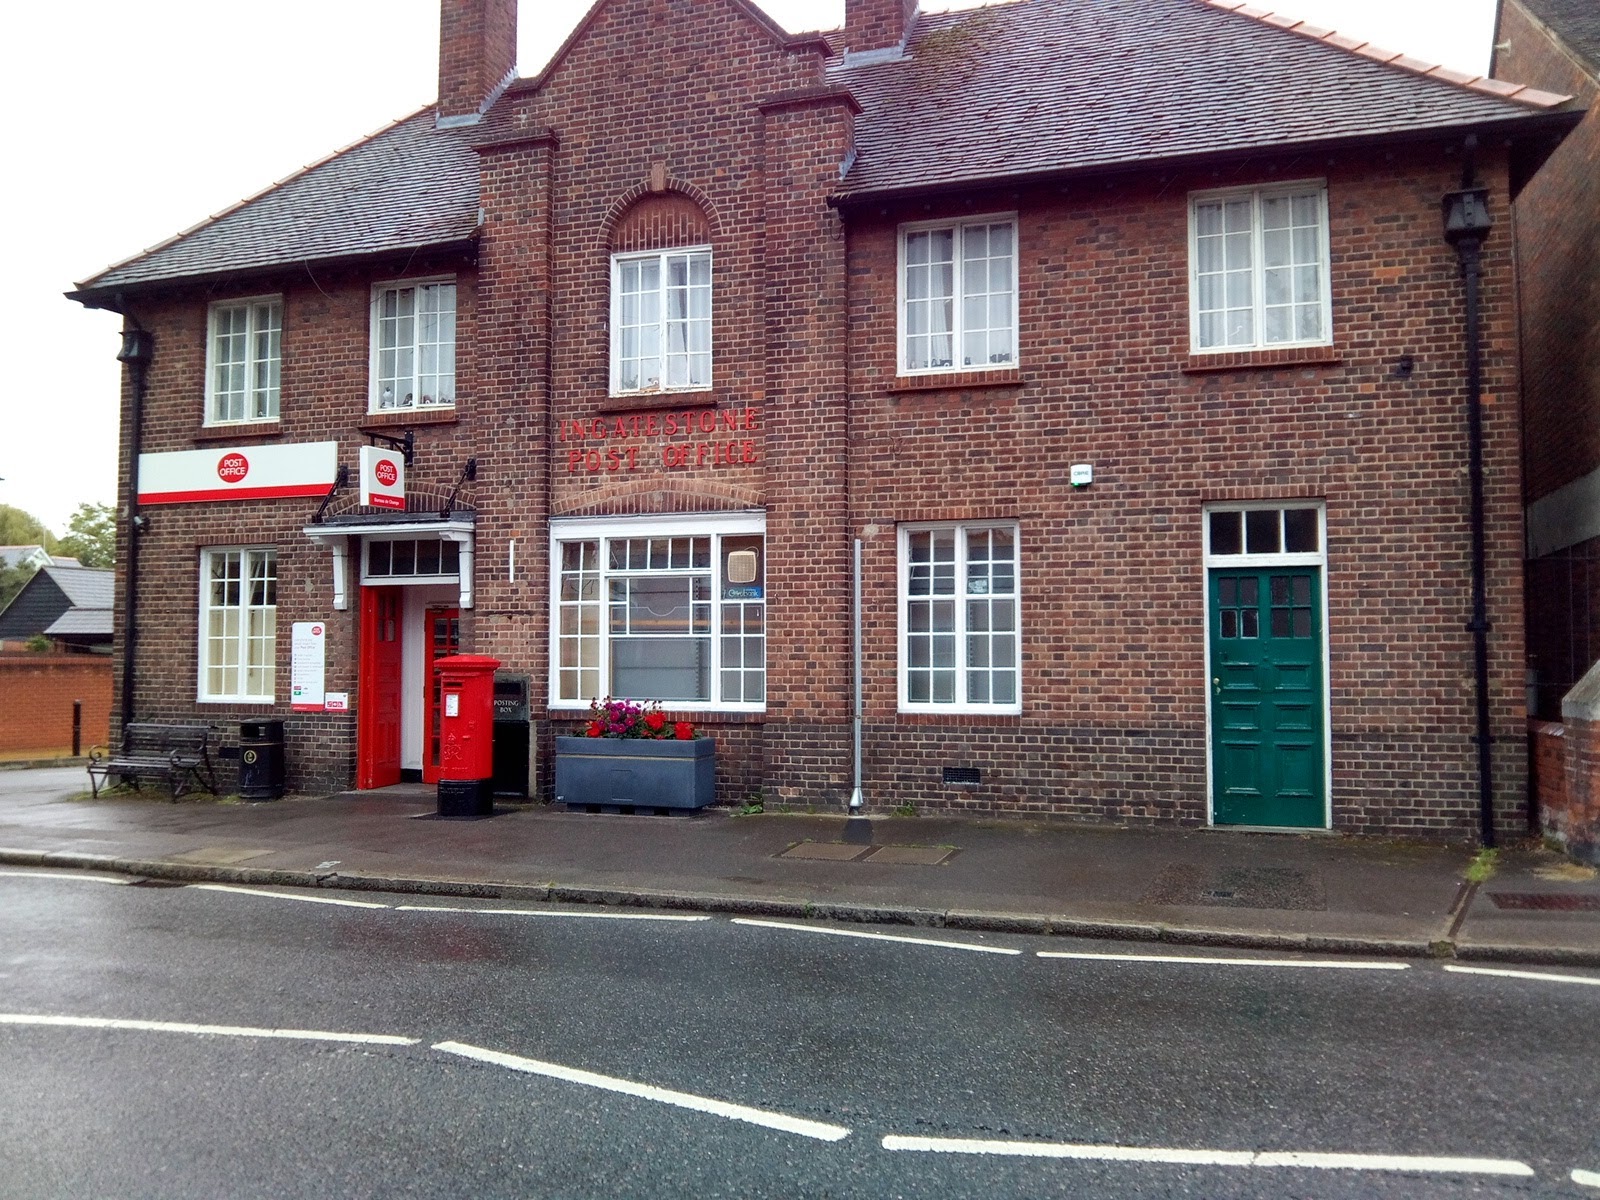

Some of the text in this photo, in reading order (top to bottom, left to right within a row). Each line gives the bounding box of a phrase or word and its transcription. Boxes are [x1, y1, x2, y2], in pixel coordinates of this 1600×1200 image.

[560, 408, 759, 441] INGATESTONE
[568, 441, 758, 472] POST OFFICE
[223, 459, 244, 468] POST
[380, 464, 394, 472] POST
[220, 467, 246, 477] OFFICE
[377, 471, 396, 480] OFFICE
